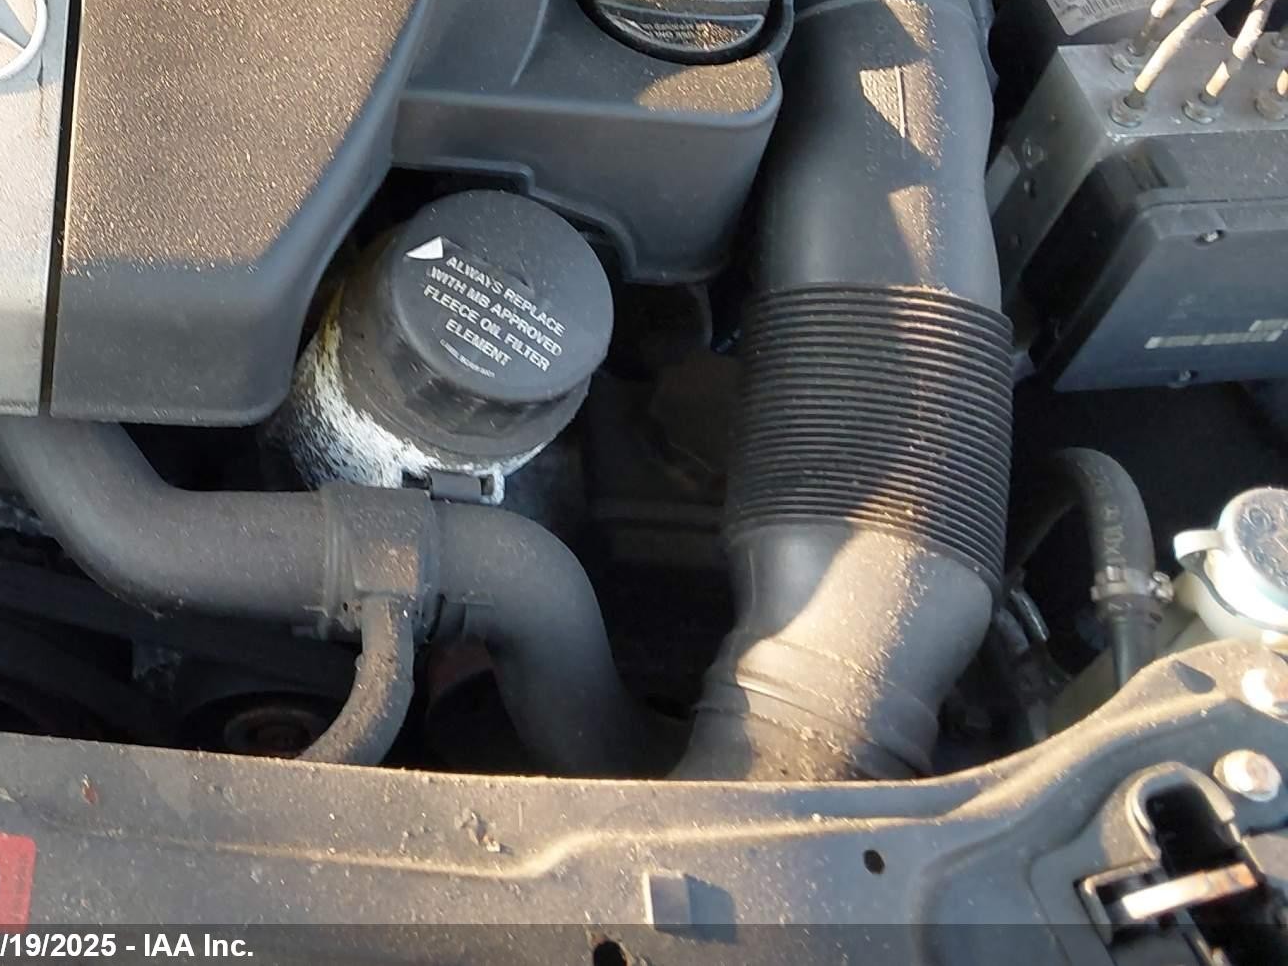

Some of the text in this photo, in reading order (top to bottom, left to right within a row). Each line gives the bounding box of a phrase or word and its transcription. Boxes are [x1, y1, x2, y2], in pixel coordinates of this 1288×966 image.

[423, 285, 480, 325] FLEECE
[479, 318, 502, 340] OIL
[503, 335, 551, 372] FILTER
[429, 265, 563, 357] WITH MB APPROVED
[446, 256, 566, 337] ALWAYS REPLACE
[445, 319, 511, 365] ELEMENT
